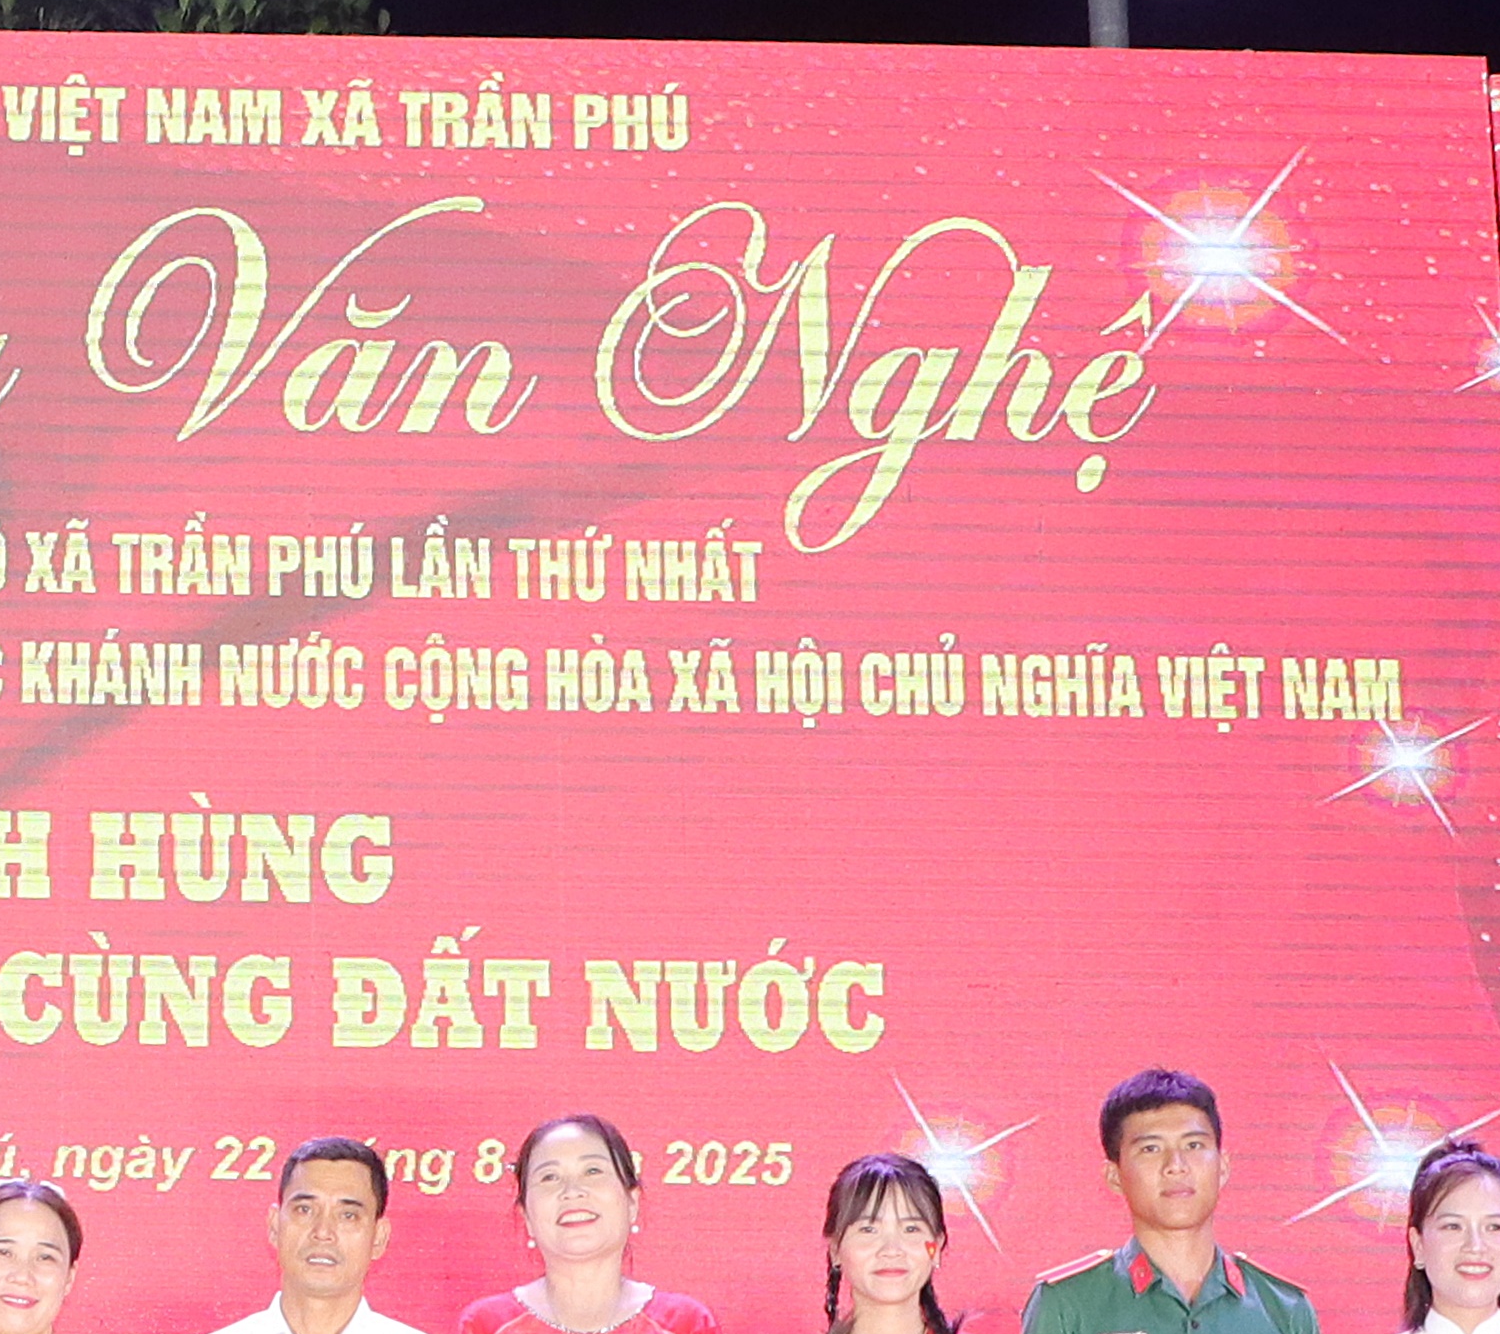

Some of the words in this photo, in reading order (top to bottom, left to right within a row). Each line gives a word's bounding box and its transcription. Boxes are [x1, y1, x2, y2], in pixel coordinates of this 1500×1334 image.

[2, 74, 127, 156] VIỆT
[145, 88, 283, 145] NAM
[301, 79, 382, 148] XÃ
[399, 72, 553, 149] TRẦN
[574, 83, 689, 151] PHÚ
[84, 196, 538, 441] Văn
[595, 200, 1157, 554] Nghệ
[25, 518, 98, 593] XÃ
[112, 512, 252, 595] TRẦN
[268, 522, 374, 599] PHÚ
[390, 515, 491, 599] LẦN
[508, 525, 613, 601] THỨ
[625, 519, 763, 602] NHẤT
[20, 628, 203, 706] KHÁNH
[219, 631, 365, 709] NƯỚC
[385, 633, 530, 723] CỘNG
[546, 635, 653, 713] HÒA
[668, 638, 741, 713] XÃ
[755, 637, 844, 728] HỘI
[860, 633, 965, 716] CHỦ
[981, 643, 1144, 717] NGHĨA
[1158, 643, 1265, 733] VIỆT
[1282, 658, 1403, 721] NAM
[90, 792, 394, 904] HÙNG
[332, 926, 551, 1049] ĐẤT
[585, 938, 885, 1053] NƯỚC
[52, 1134, 195, 1192] ngày
[211, 1134, 277, 1181] 22
[663, 1140, 793, 1186] 2025
